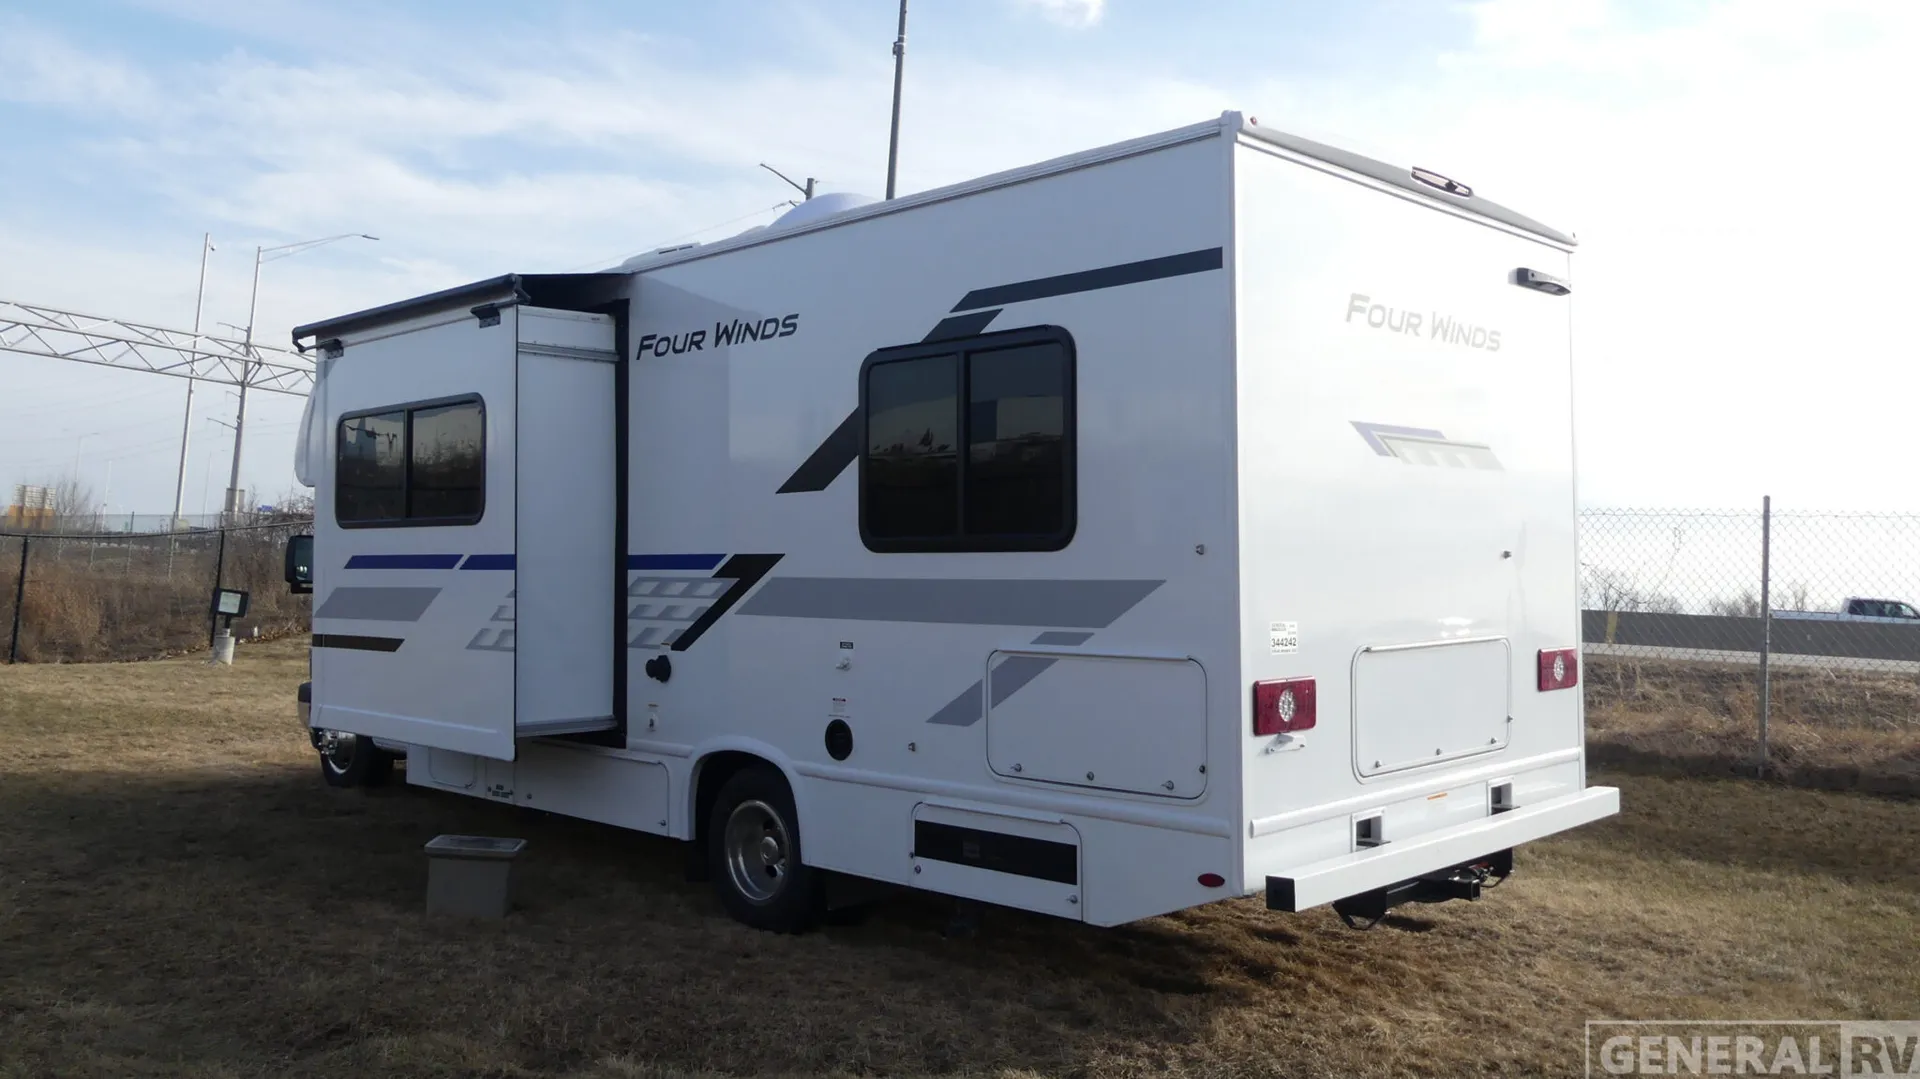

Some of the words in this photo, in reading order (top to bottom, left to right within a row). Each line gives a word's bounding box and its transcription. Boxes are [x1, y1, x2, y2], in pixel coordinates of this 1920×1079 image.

[636, 330, 706, 360] FOUR
[714, 313, 799, 348] WINDS
[1346, 293, 1422, 337] FOUR
[1431, 311, 1501, 352] WINDS
[1271, 637, 1297, 648] 344242
